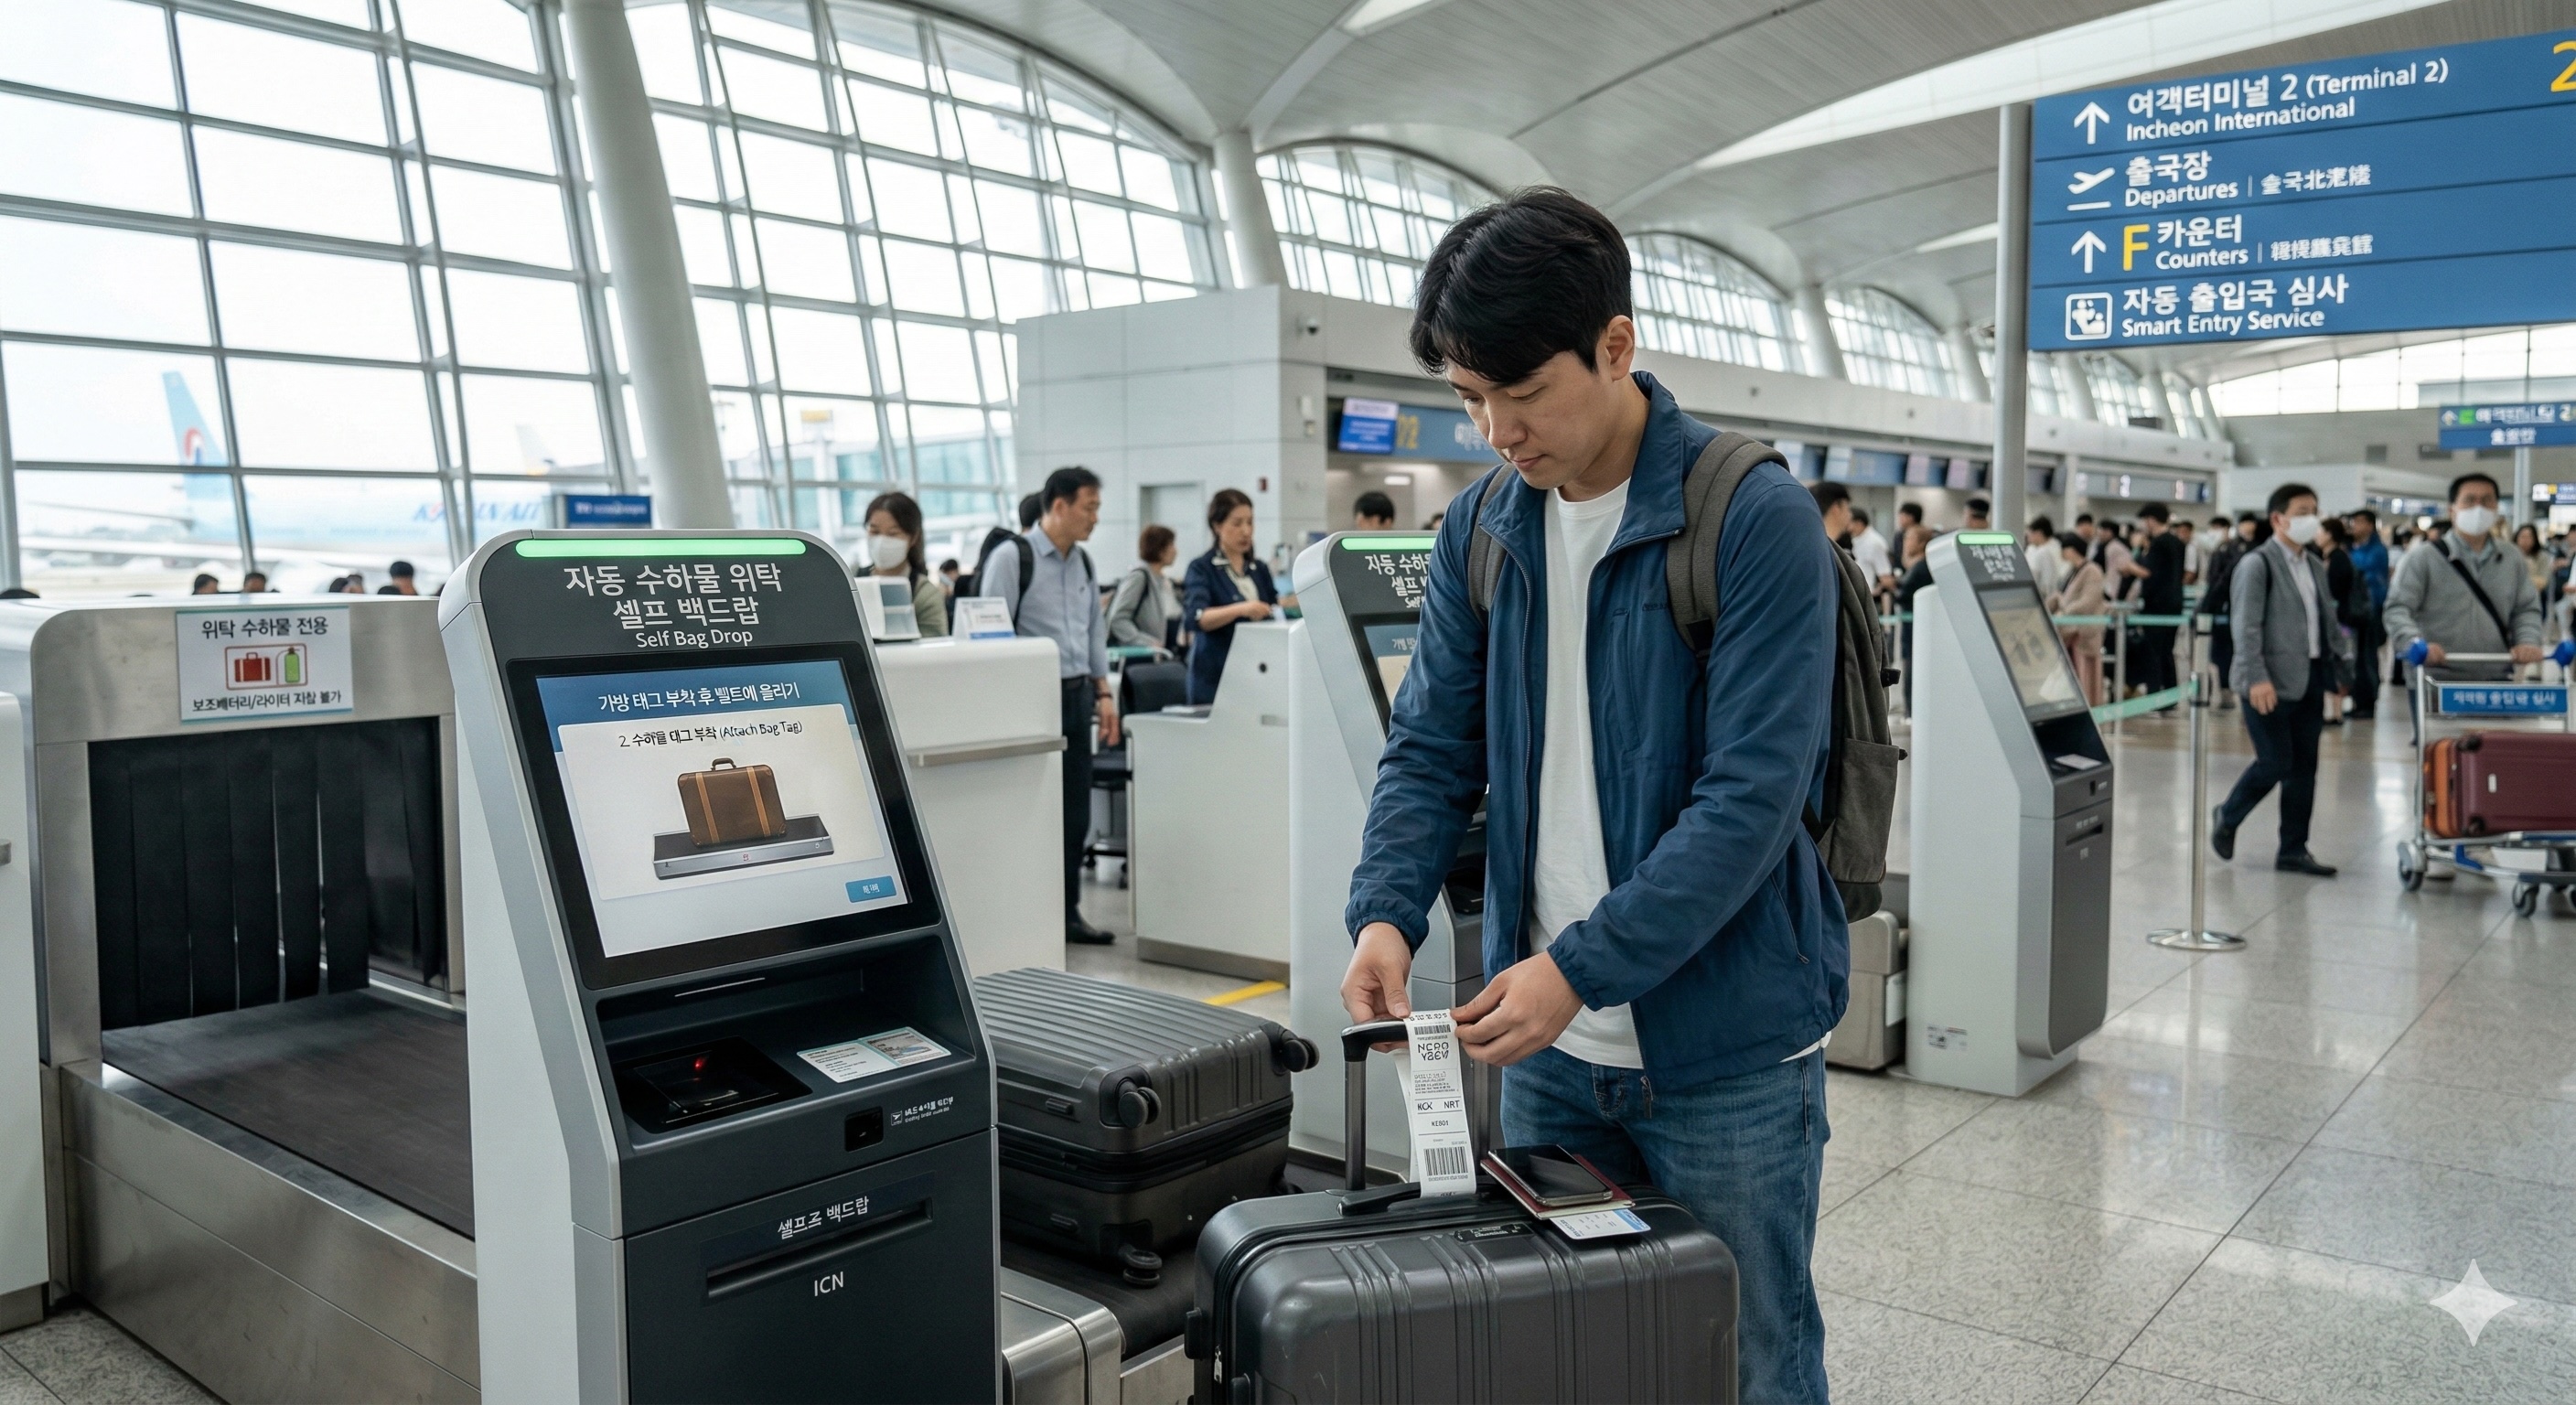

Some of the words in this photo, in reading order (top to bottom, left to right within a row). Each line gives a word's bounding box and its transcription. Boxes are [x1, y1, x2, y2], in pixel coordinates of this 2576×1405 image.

[2128, 75, 2270, 117] 여객터미널
[2280, 74, 2298, 102] 2
[2306, 62, 2417, 100] (Terminal
[2424, 58, 2449, 84] 2)
[2127, 116, 2208, 142] Incheon
[2214, 96, 2356, 132] International
[2125, 150, 2213, 187] 출국장
[2125, 182, 2238, 209] Departures
[2122, 224, 2151, 272] F
[2156, 214, 2243, 248] 카운터
[2155, 248, 2249, 270] Counters
[2122, 284, 2181, 316] 자동
[2188, 278, 2278, 314] 출입국
[2288, 273, 2350, 307] 심사
[2121, 317, 2183, 338] Smart
[2187, 313, 2244, 337] Entry
[2248, 307, 2325, 331] Service
[564, 564, 626, 596] 자동
[636, 563, 722, 595] 수하물
[729, 563, 783, 593] 위탁
[613, 598, 673, 630] 셀프
[677, 595, 760, 627] 백드랍
[201, 619, 236, 639] 위탁
[241, 617, 292, 638] 수하물
[296, 616, 329, 636] 전용
[635, 630, 671, 649] Self
[673, 629, 709, 649] Bag
[710, 628, 754, 648] Drop
[598, 692, 630, 713] 가방
[631, 692, 665, 710] 태그
[665, 688, 696, 708] 부착
[697, 687, 715, 706] 후
[694, 725, 717, 742] 부착
[1444, 1099, 1460, 1110] NRT
[826, 1195, 870, 1223] 백드랍
[814, 1271, 844, 1297] ICN
